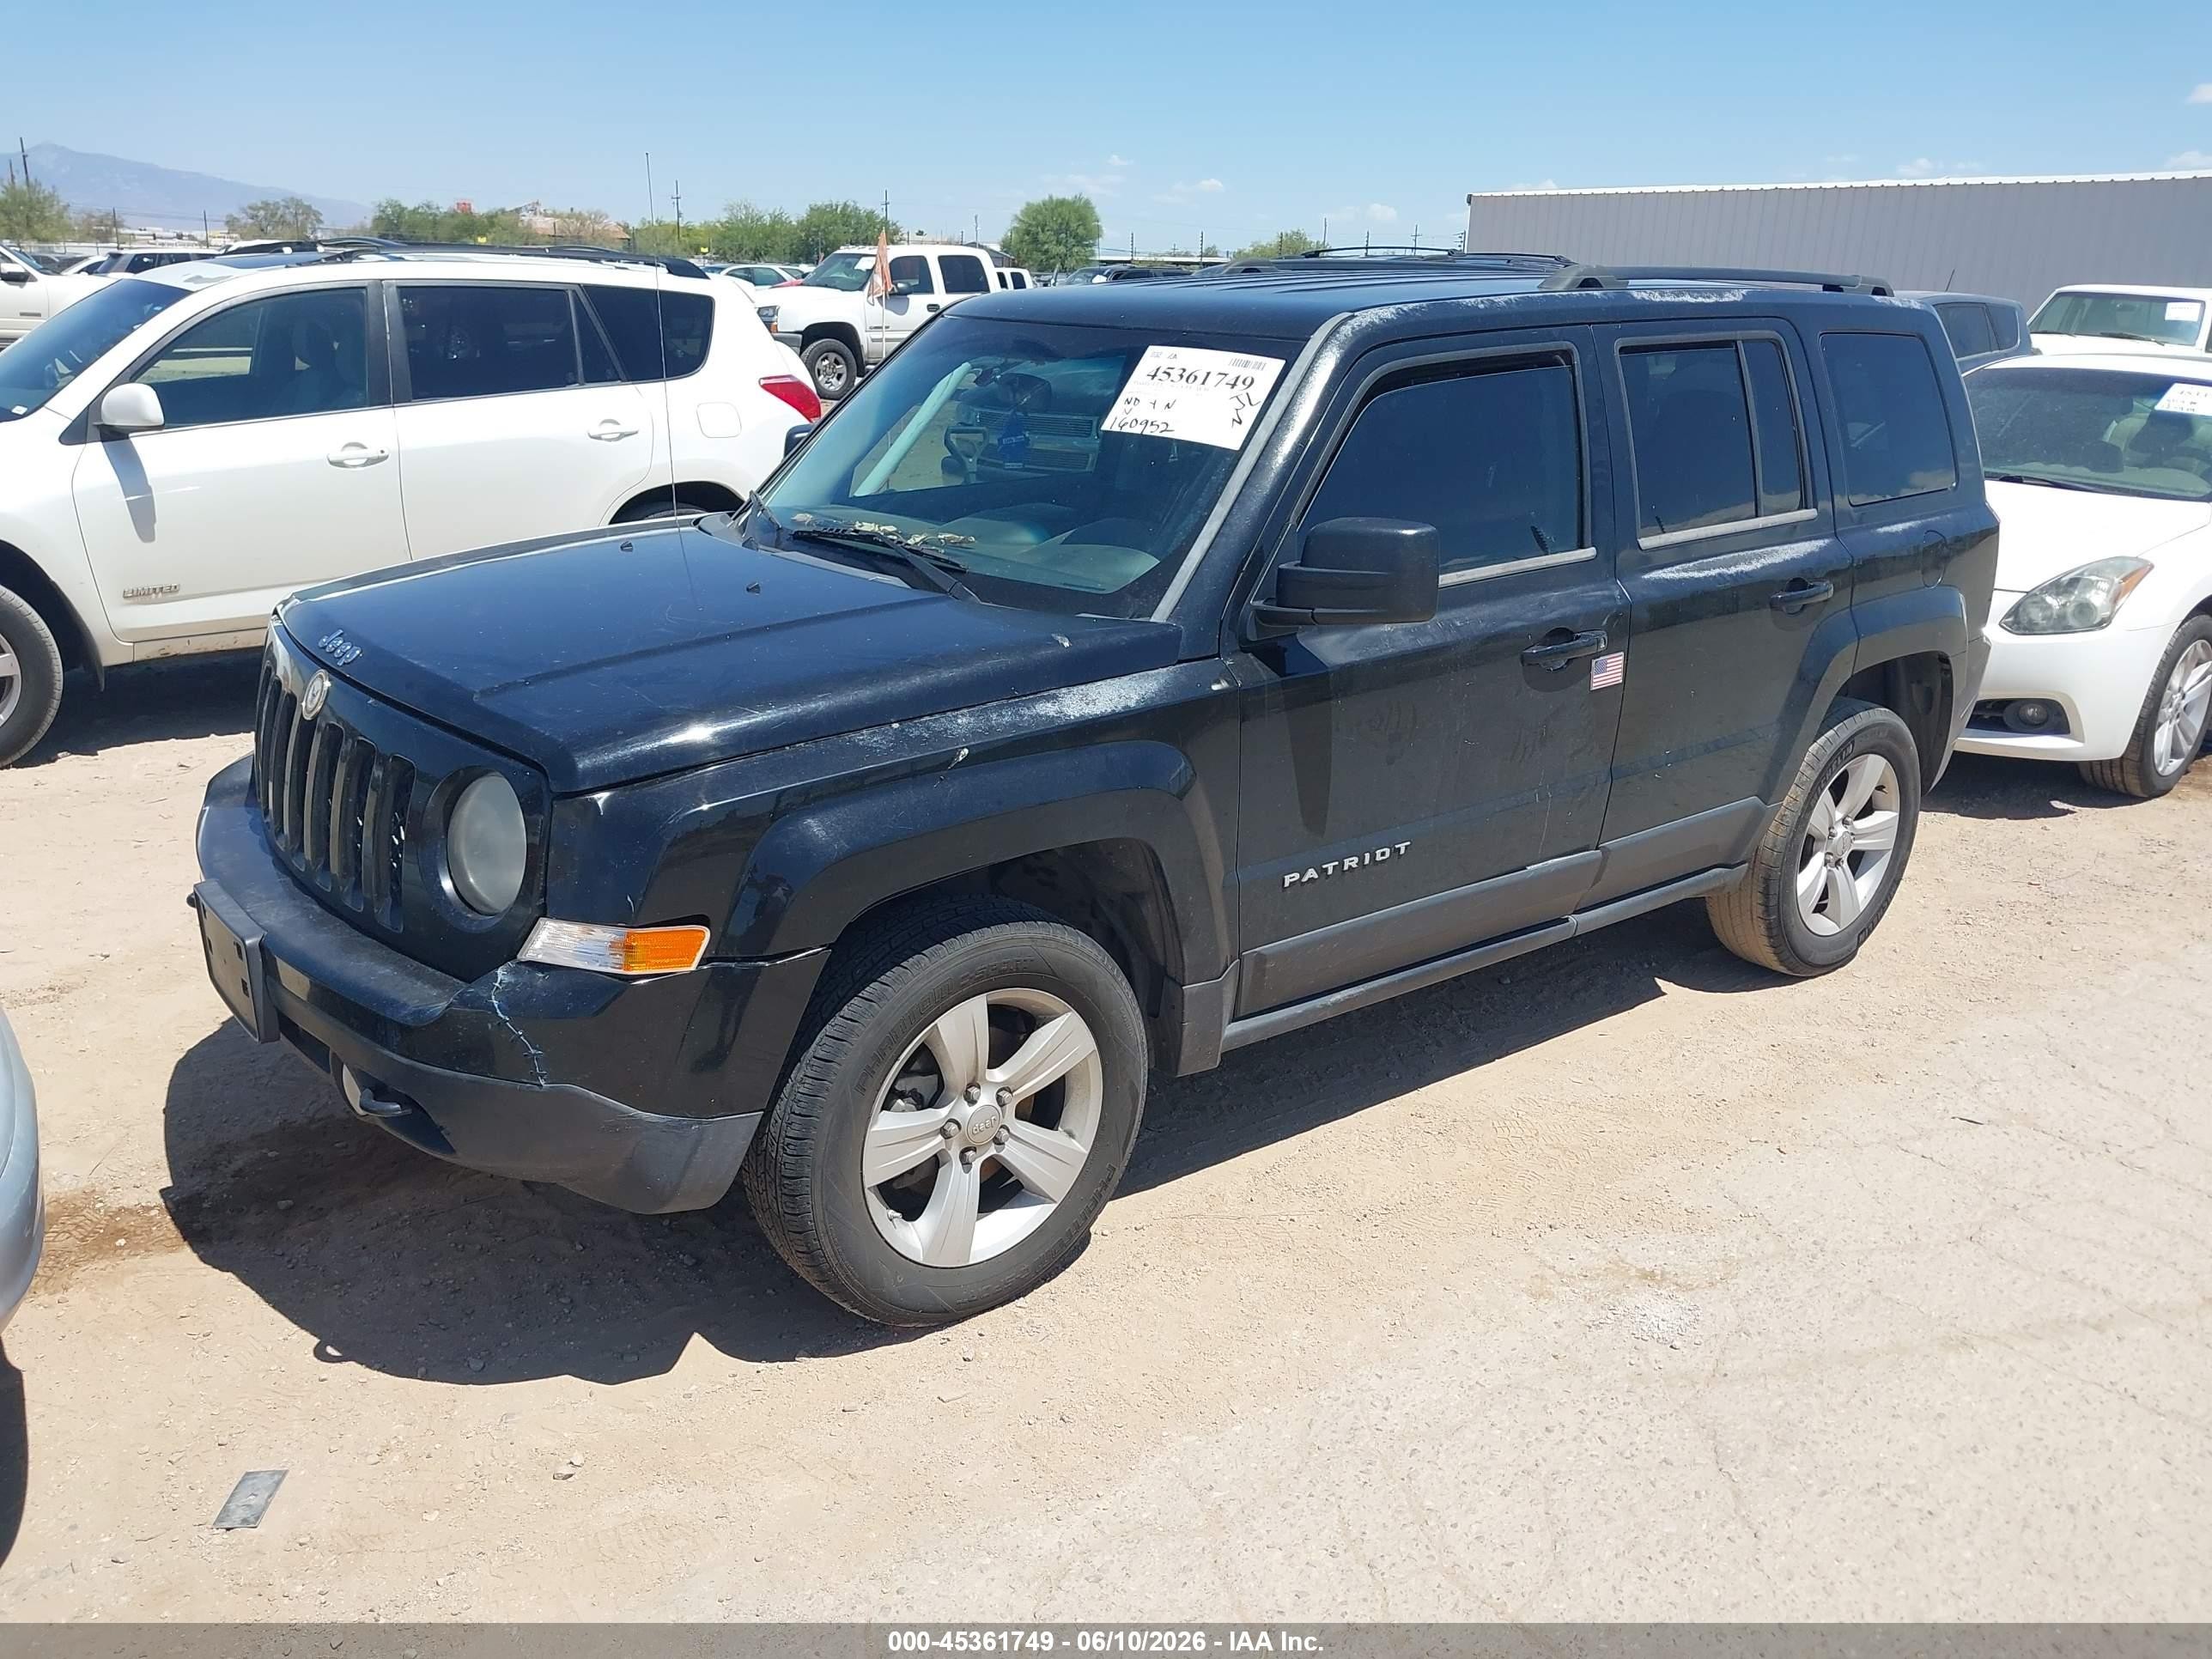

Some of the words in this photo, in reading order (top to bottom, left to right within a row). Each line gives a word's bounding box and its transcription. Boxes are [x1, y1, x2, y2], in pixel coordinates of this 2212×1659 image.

[1146, 365, 1255, 392] 45361749
[1109, 416, 1176, 435] 160952
[123, 583, 179, 599] LIMITED
[1283, 841, 1412, 889] PATRIOT
